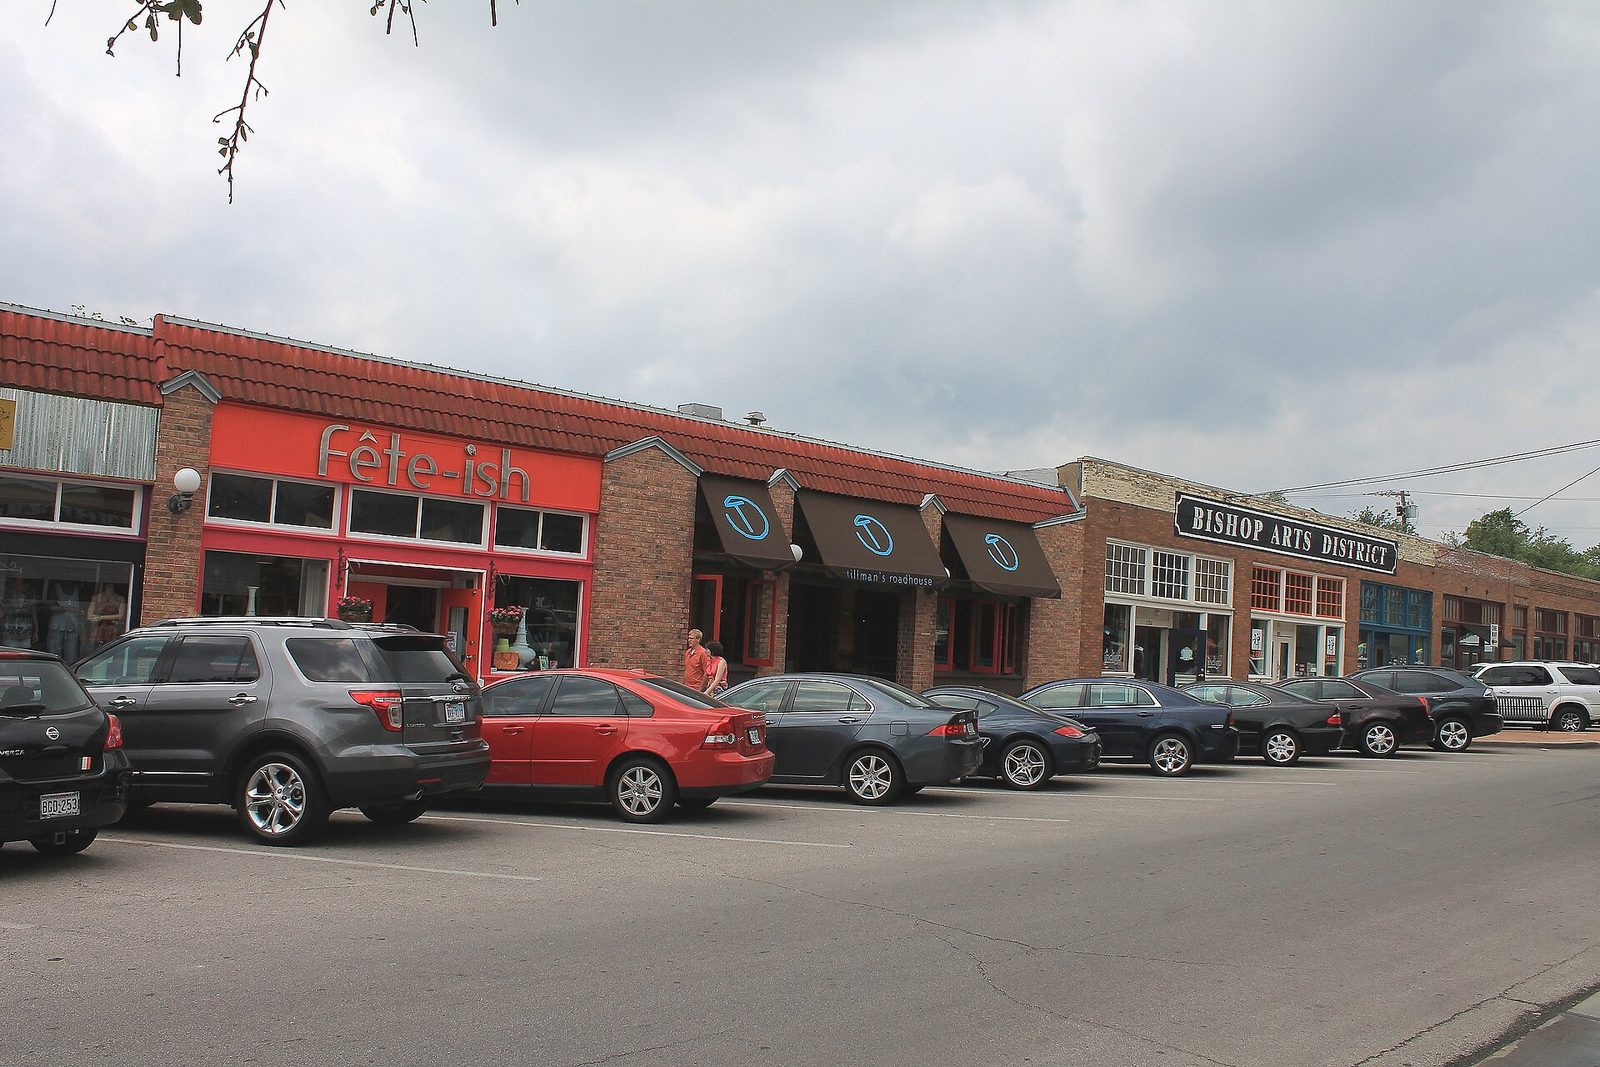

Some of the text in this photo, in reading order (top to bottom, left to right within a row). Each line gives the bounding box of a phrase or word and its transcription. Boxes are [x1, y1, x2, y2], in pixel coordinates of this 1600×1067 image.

[1191, 506, 1388, 566] BISHOP ARTS DISTRICT
[846, 569, 933, 586] tillman's roadhouse
